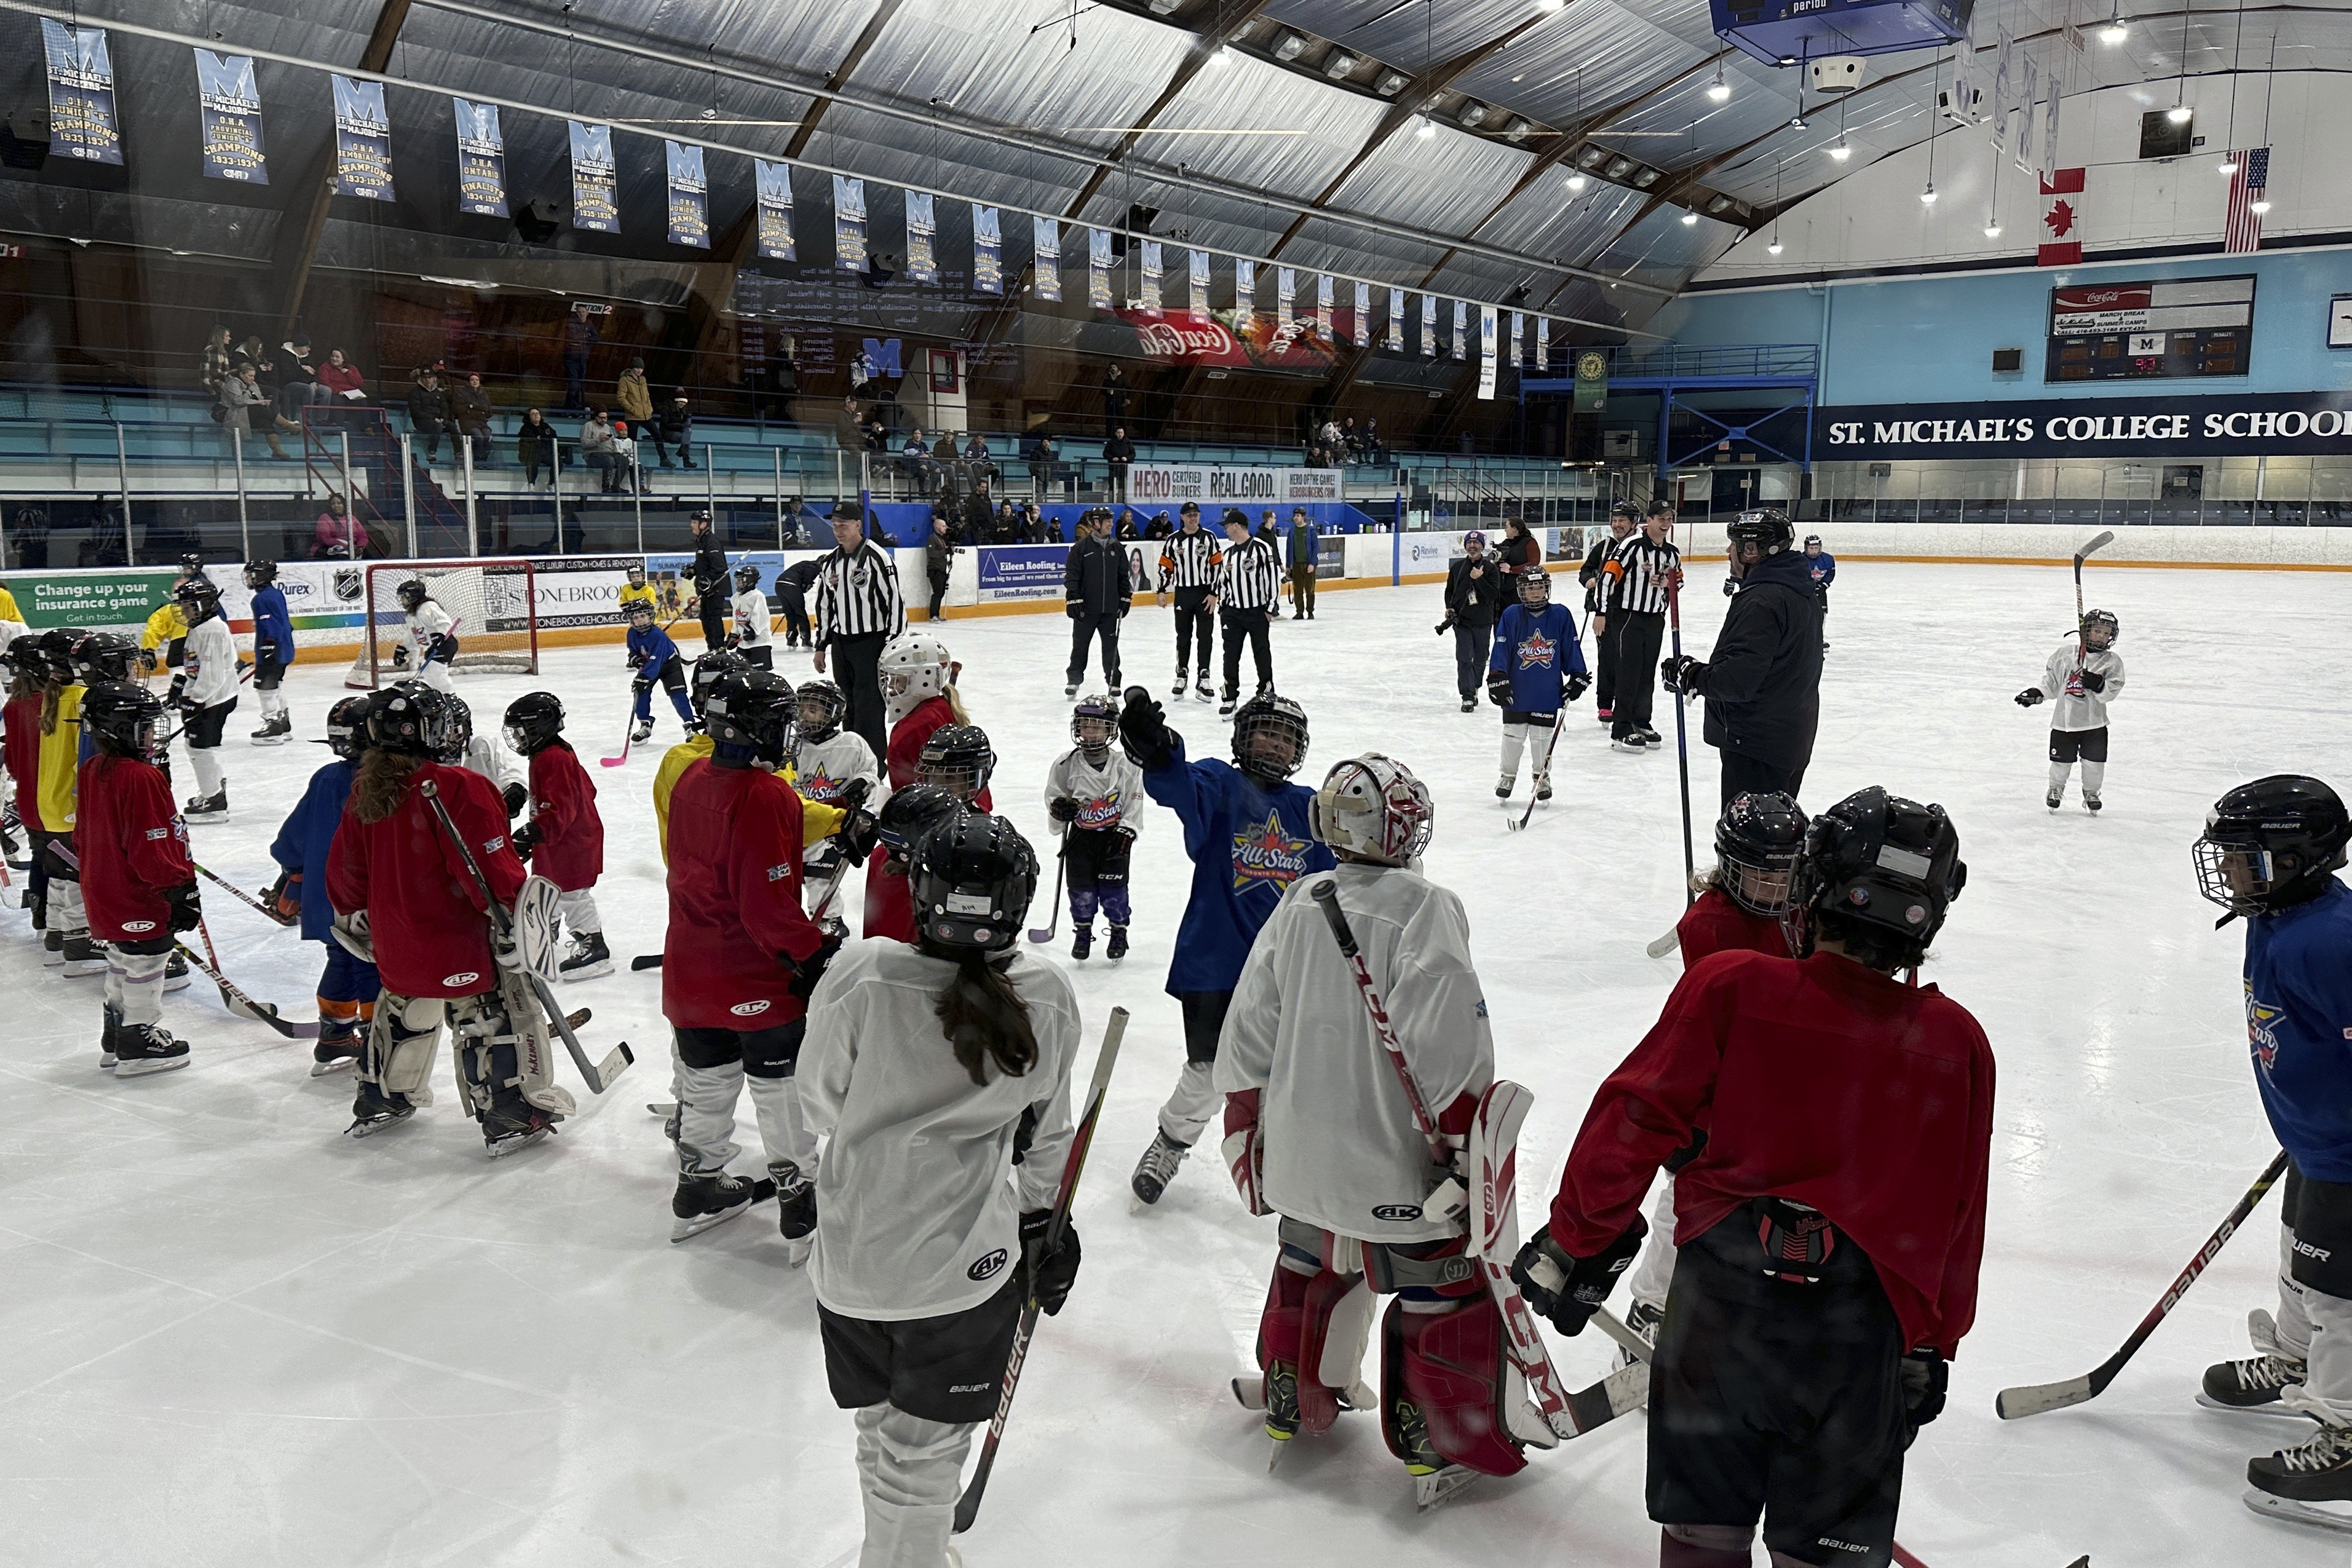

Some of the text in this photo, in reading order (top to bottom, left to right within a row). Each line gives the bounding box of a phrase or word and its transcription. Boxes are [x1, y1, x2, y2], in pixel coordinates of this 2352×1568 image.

[39, 17, 111, 73] M
[47, 65, 111, 84] ST. MICHAEL'S
[193, 48, 259, 98] M
[201, 92, 258, 109] ST. MICHAEL'S
[331, 74, 389, 121] M
[52, 105, 90, 119] JUNIOR
[213, 103, 248, 115] MAJORS
[220, 116, 247, 127] O.H.A.
[349, 118, 387, 132] MICHAEL'S
[453, 97, 502, 142] M
[50, 120, 119, 141] CHAMPIONS
[210, 125, 253, 137] PROVINCIAL
[212, 133, 239, 142] JUNIOR
[347, 125, 377, 138] MAJORS
[60, 132, 109, 147] 1933-1934
[469, 138, 501, 151] MICHAEL'S
[568, 119, 614, 161] M
[204, 143, 265, 163] CHAMPIONS
[352, 143, 377, 153] O.H.A.
[212, 155, 257, 168] 1933-1934
[377, 156, 391, 165] CUP
[471, 157, 494, 168] O.H.A.
[581, 159, 613, 170] MICHAEL'S
[665, 140, 707, 180] M
[338, 162, 393, 182] CHAMPIONS
[464, 167, 499, 179] ONTARIO
[754, 159, 793, 194] M
[345, 174, 385, 187] 1933-1934
[461, 182, 505, 199] FINALISTS
[832, 174, 866, 210] M
[575, 199, 619, 215] CHAMPIONS
[670, 215, 708, 232] CHAMPIONS
[759, 230, 795, 245] CHAMPIONS
[603, 305, 612, 314] 2
[2140, 339, 2154, 349] M
[863, 338, 903, 378] M
[1829, 422, 1866, 445] ST.
[1873, 418, 2033, 443] MICHAEL'S
[2046, 414, 2190, 441] COLLEGE
[1133, 470, 1170, 497] HERO
[566, 560, 588, 569] CUSTOM
[590, 559, 607, 568] HOMES
[612, 558, 644, 567] RENOVATIONS
[1000, 562, 1024, 571] Eileen
[1026, 561, 1056, 571] Roofing
[34, 584, 148, 598] Change up your
[277, 582, 309, 595] Purex
[338, 576, 358, 596] NHL
[994, 588, 1056, 599] EileenRoofing.com
[509, 585, 622, 603] STONEBROO
[36, 597, 148, 611] insurance game
[66, 614, 84, 622] Get
[87, 612, 94, 621] in
[1242, 868, 1270, 876] TORONTO
[214, 877, 257, 909] BAUER
[197, 961, 252, 1006] BAUER
[2293, 1238, 2331, 1262] UER
[2161, 1221, 2235, 1315] BAUER
[949, 1382, 991, 1393] BAUER
[989, 1325, 1029, 1439] BAUER
[1818, 1537, 1870, 1554] BAUER
